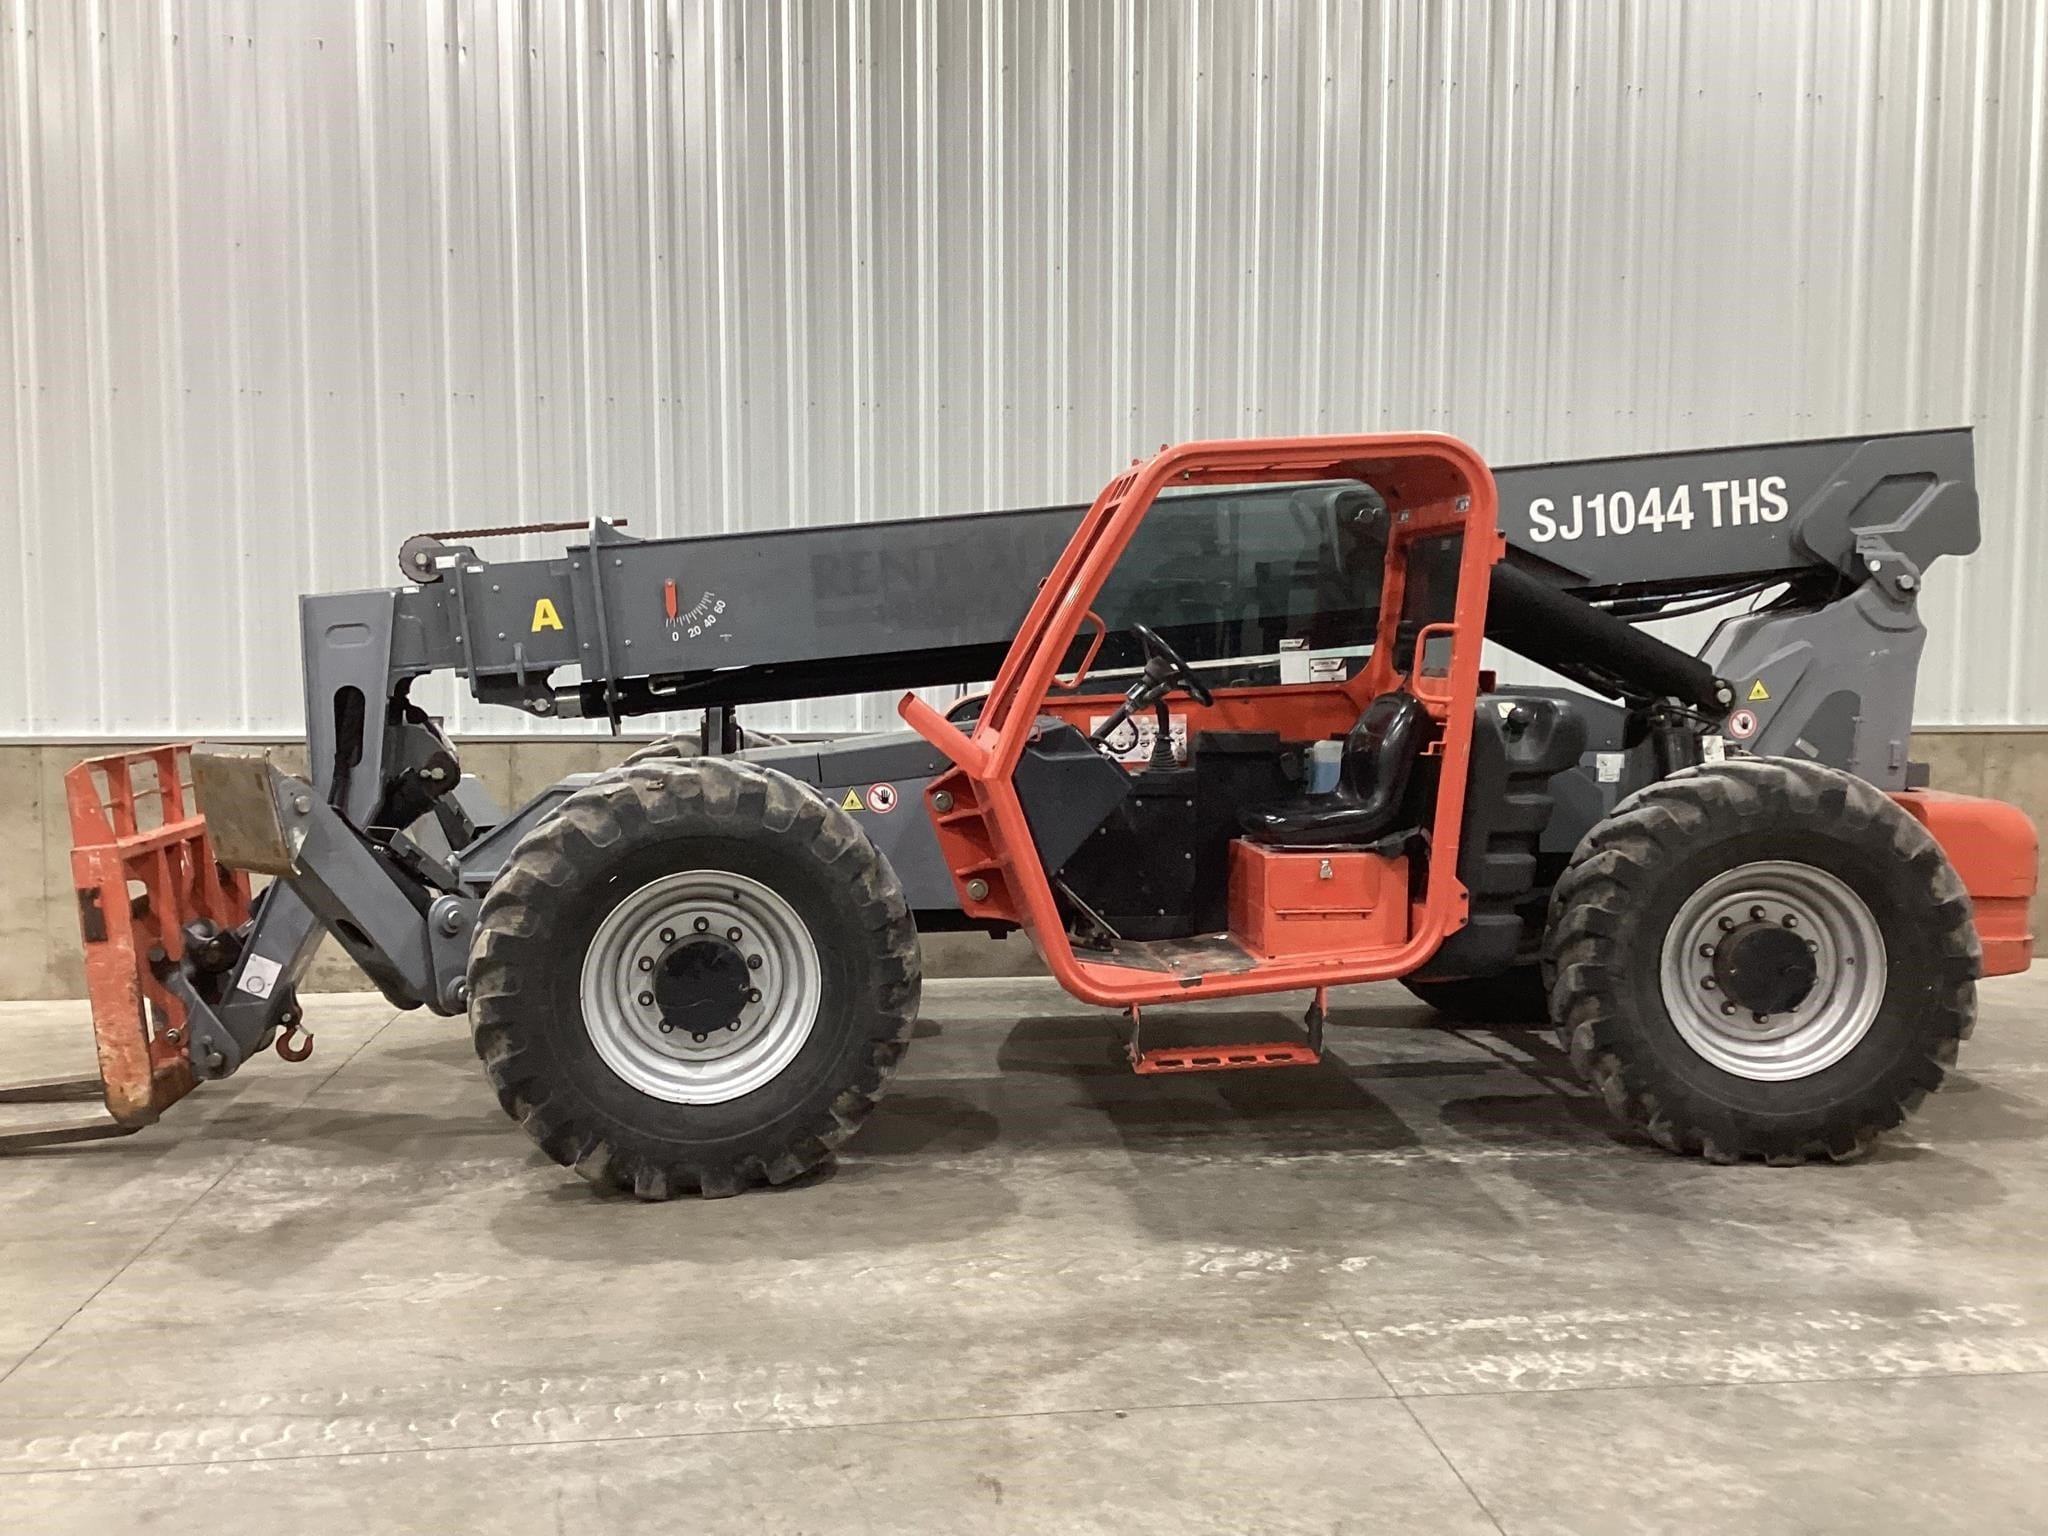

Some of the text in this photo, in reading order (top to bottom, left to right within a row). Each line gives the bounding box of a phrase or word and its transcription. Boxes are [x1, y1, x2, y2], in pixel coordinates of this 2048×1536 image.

[1529, 476, 1789, 543] SJ1044 THS
[531, 598, 564, 632] A
[671, 599, 726, 641] 0 20 40 60
